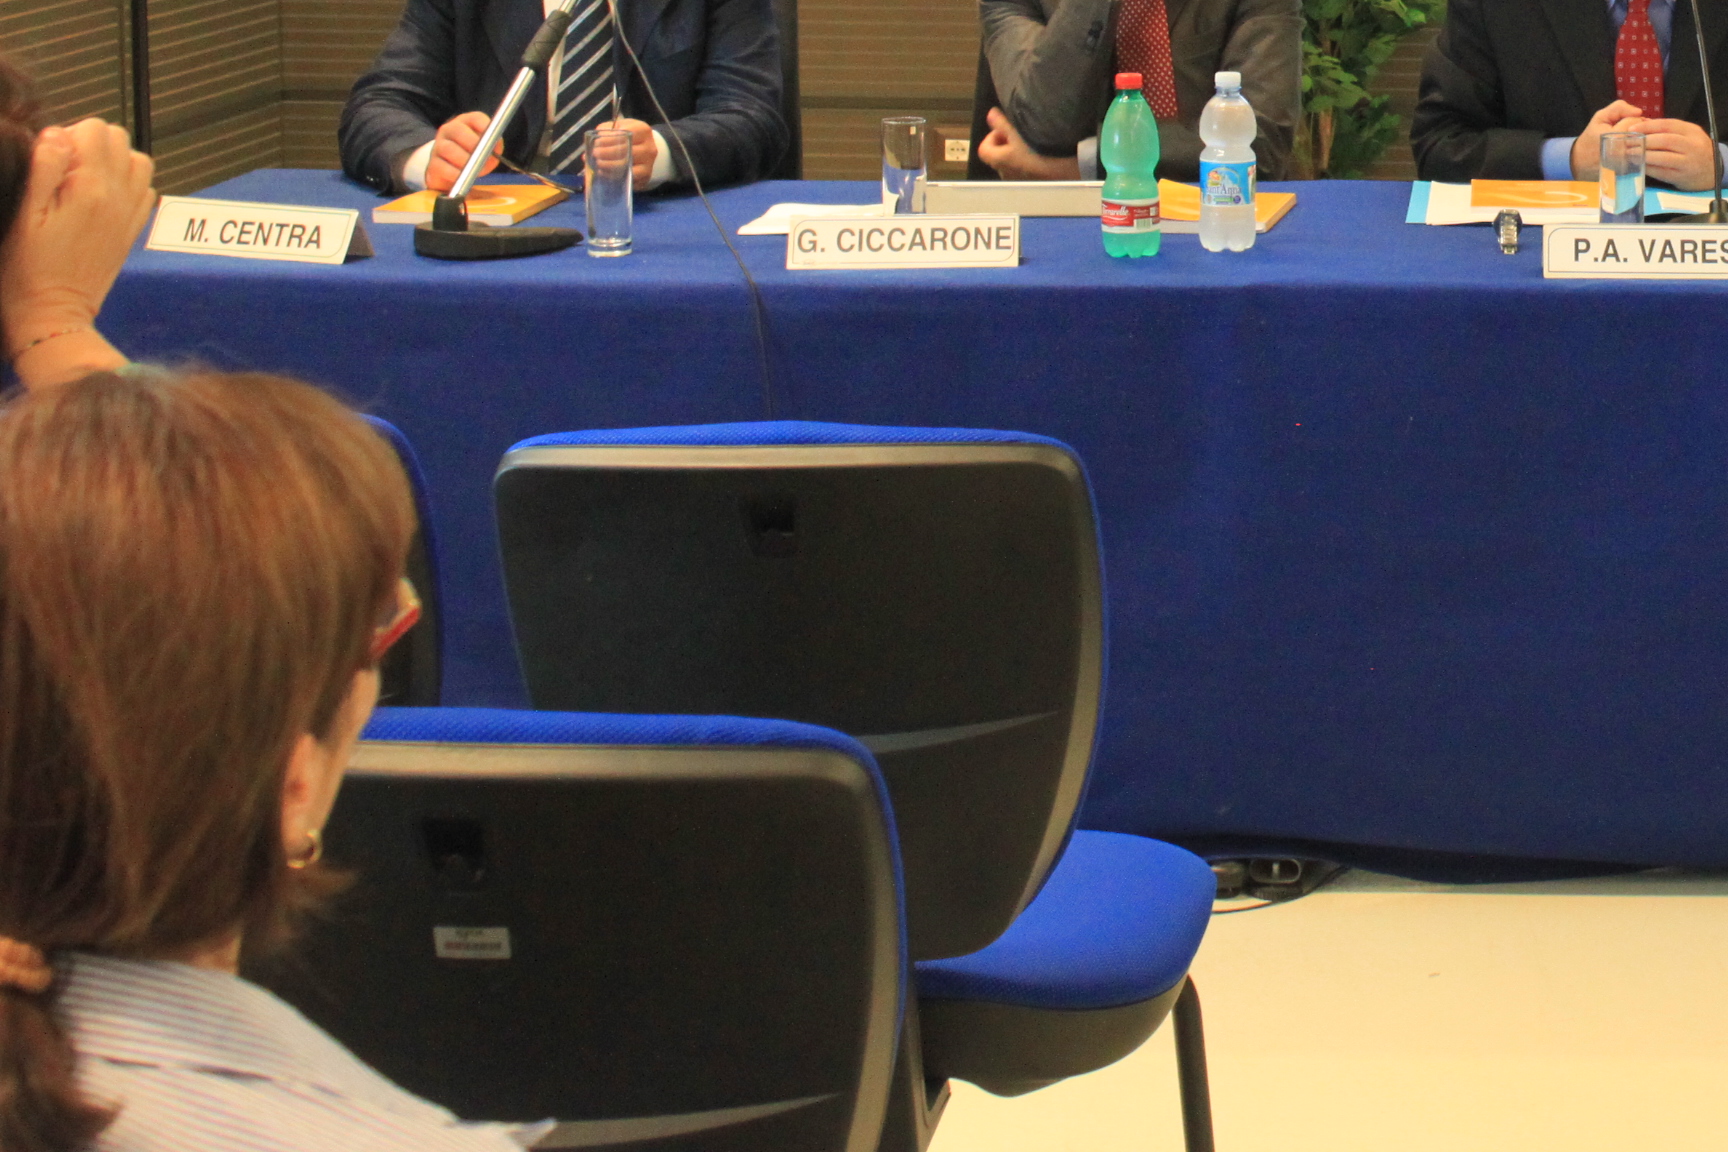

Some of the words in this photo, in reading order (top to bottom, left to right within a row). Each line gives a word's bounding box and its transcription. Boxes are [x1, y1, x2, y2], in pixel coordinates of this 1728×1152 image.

[183, 217, 209, 243] M.
[219, 219, 321, 249] CENTRA
[797, 228, 826, 254] G.
[836, 226, 1012, 253] CICCARONE
[1574, 238, 1628, 263] P.A.
